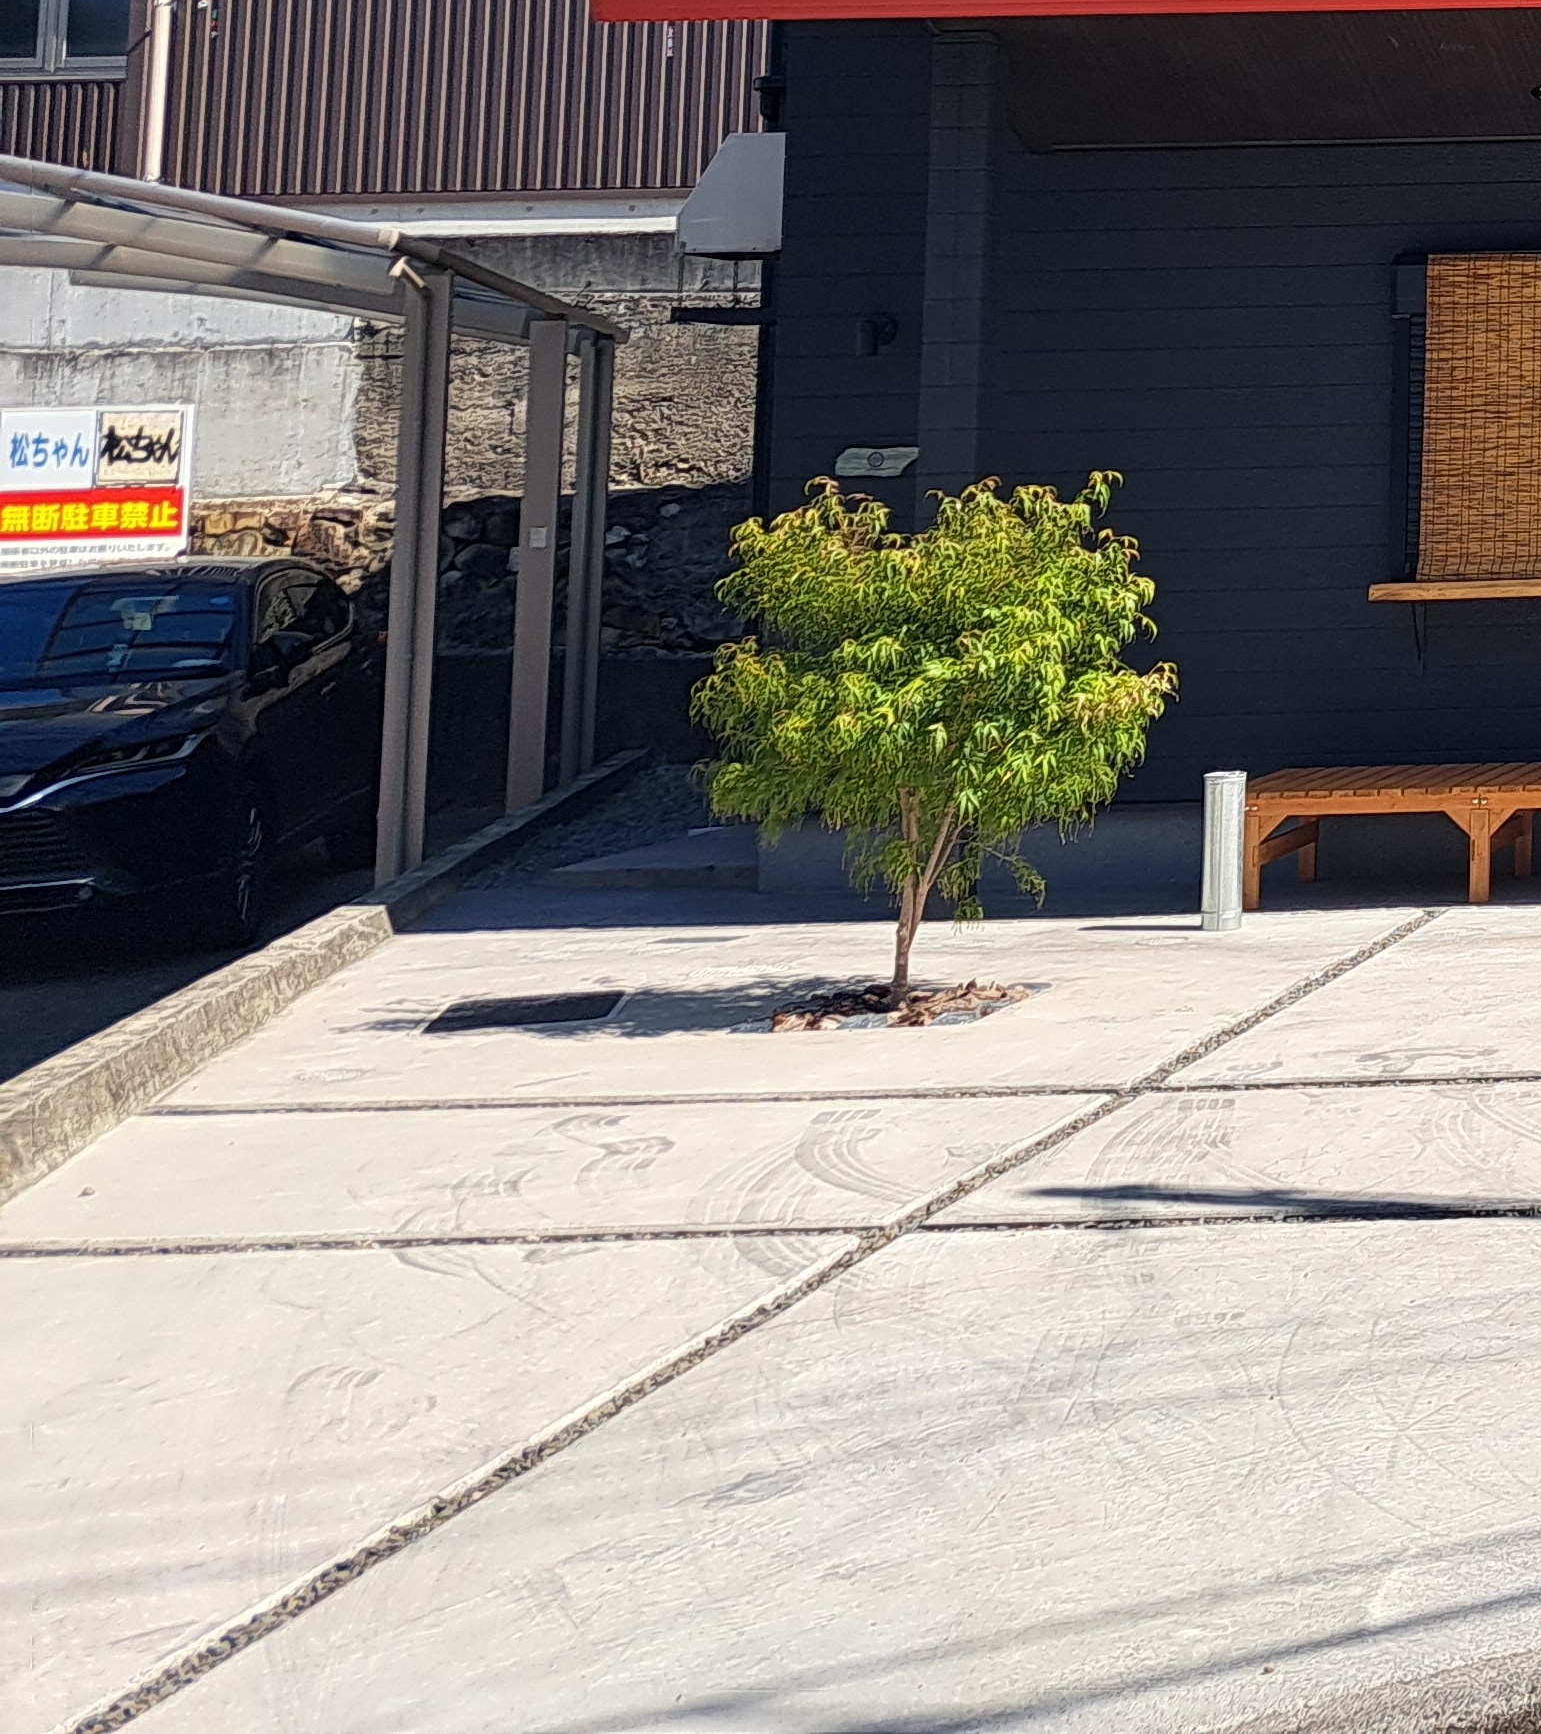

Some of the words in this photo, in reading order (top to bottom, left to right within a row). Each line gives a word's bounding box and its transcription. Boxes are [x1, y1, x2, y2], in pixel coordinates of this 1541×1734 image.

[9, 431, 90, 469] 松ちゃん
[1, 501, 178, 532] 無断駐車禁止
